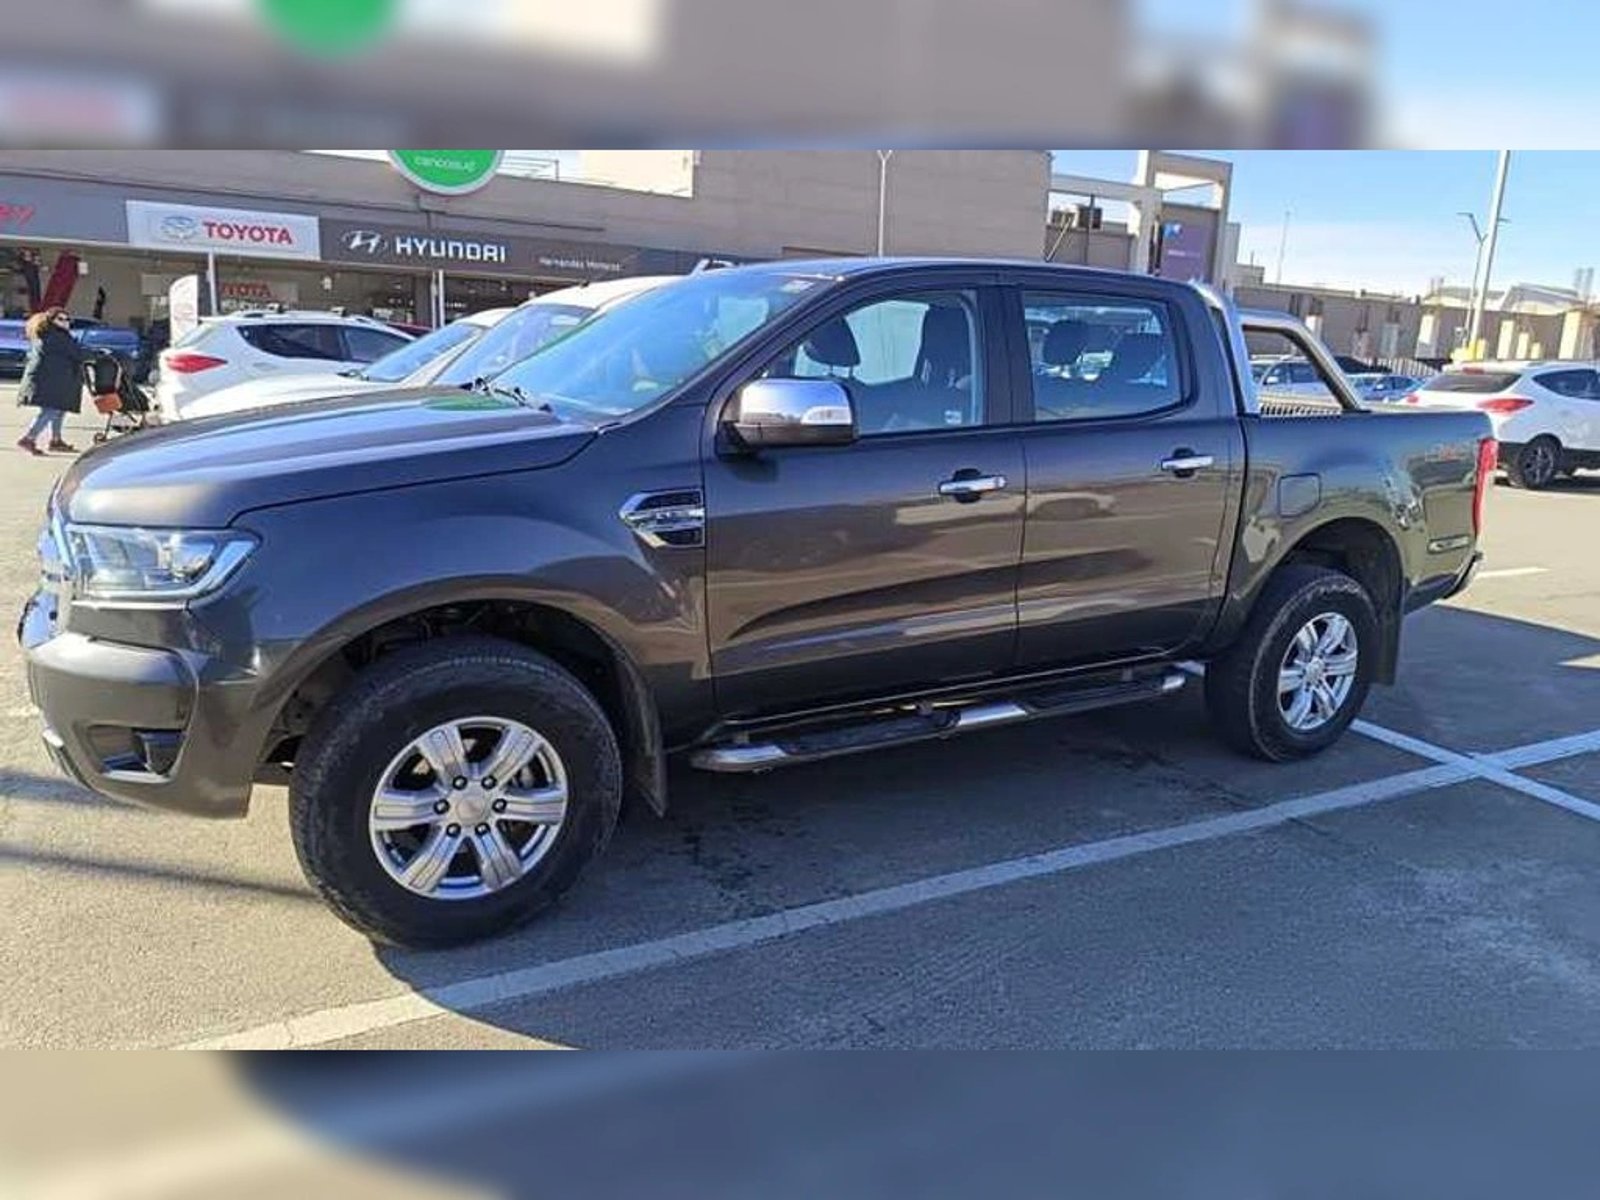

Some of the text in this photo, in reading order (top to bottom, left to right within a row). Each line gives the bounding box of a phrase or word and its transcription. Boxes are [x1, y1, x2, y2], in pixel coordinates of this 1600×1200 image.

[203, 221, 293, 245] TOYOTA
[395, 236, 507, 263] HYUNDAI
[220, 280, 272, 299] OYOTA
